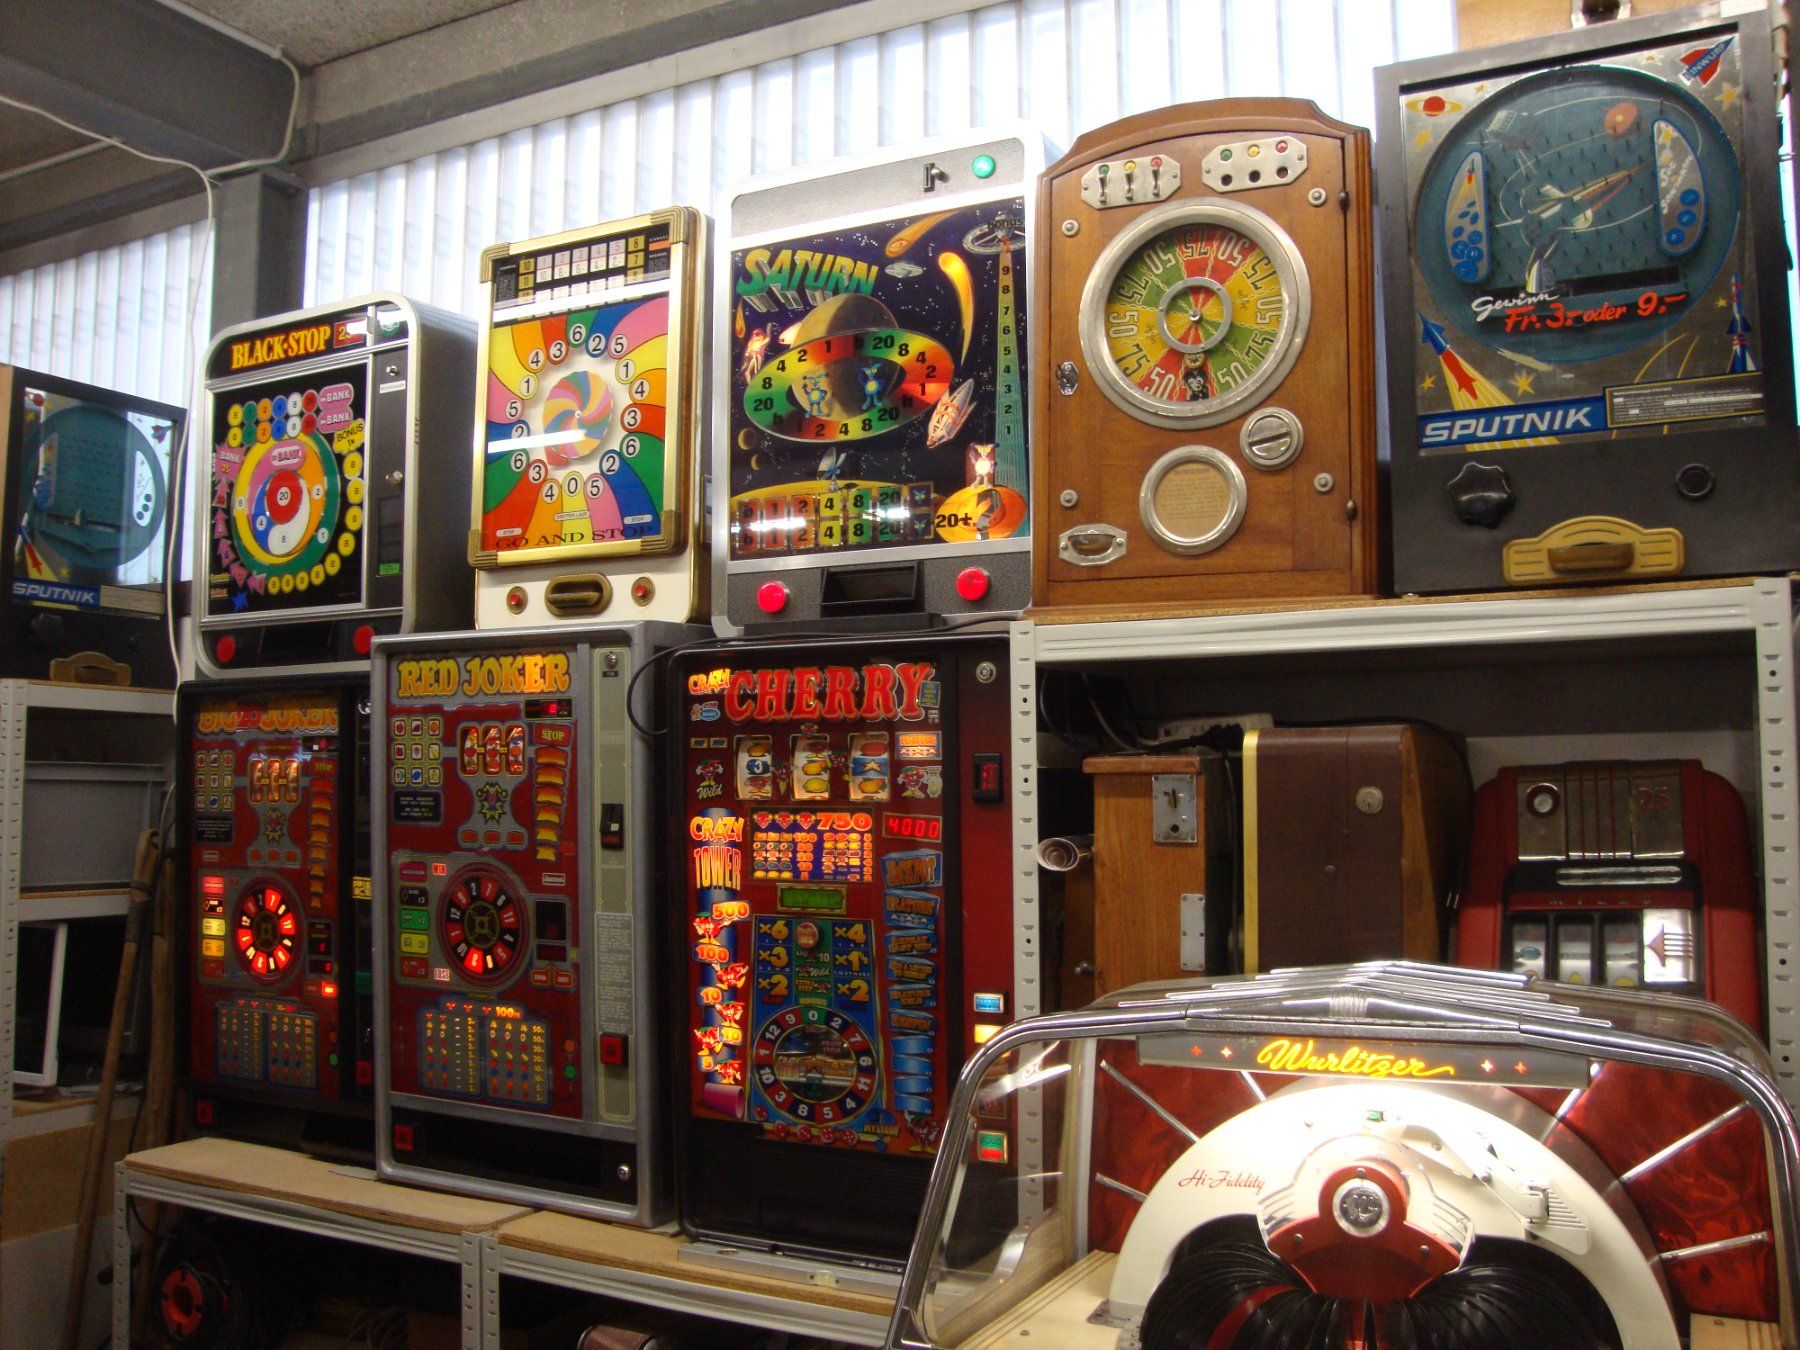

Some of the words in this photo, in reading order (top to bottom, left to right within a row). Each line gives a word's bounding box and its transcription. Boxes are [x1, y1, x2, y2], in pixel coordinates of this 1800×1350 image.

[634, 255, 638, 265] 7
[736, 248, 879, 296] SATURN
[1002, 266, 1010, 275] 9
[1002, 285, 1010, 294] 8
[1003, 306, 1010, 315] 7
[1471, 292, 1560, 322] Gewinn
[1505, 305, 1543, 332] Fr.
[1583, 303, 1627, 323] oder
[572, 325, 583, 342] 6
[1003, 326, 1010, 335] 6
[592, 335, 602, 352] 2
[614, 337, 624, 353] 5
[873, 335, 895, 349] 20
[553, 343, 563, 358] 3
[798, 349, 808, 363] 2
[898, 343, 909, 357] 8
[916, 351, 926, 364] 4
[1004, 347, 1011, 355] 5
[531, 351, 540, 367] 4
[776, 360, 787, 372] 4
[623, 362, 630, 378] 1
[925, 365, 937, 379] 2
[1004, 365, 1011, 374] 4
[524, 379, 531, 394] 1
[634, 381, 645, 398] 4
[762, 376, 772, 390] 8
[1004, 385, 1012, 393] 3
[326, 388, 351, 404] BANK
[510, 400, 518, 417] 5
[754, 400, 773, 411] 20
[1004, 405, 1012, 414] 2
[326, 412, 351, 425] BANK
[627, 409, 637, 427] 3
[877, 407, 899, 421] 20
[515, 425, 524, 438] 2
[816, 424, 825, 436] 2
[839, 422, 849, 436] 4
[861, 418, 872, 431] 8
[1006, 426, 1011, 434] 1
[1423, 406, 1592, 443] SPUTNIK
[336, 424, 363, 443] BONUS
[626, 438, 637, 455] 6
[513, 453, 524, 469] 6
[605, 455, 616, 472] 2
[532, 465, 542, 481] 3
[545, 484, 555, 501] 4
[568, 478, 578, 494] 0
[590, 479, 600, 496] 5
[279, 490, 289, 501] 20
[824, 497, 834, 511] 4
[853, 493, 864, 509] 8
[496, 537, 528, 549] GO
[536, 532, 585, 546] AND
[592, 526, 653, 540] STOP
[824, 525, 834, 539] 4
[853, 523, 864, 538] 8
[12, 582, 96, 604] SPUTNIK
[398, 659, 459, 697] RED
[463, 653, 569, 696] JOKER
[689, 669, 730, 694] CRAZY
[724, 664, 932, 721] CHERRY
[542, 729, 564, 741] STOP
[754, 761, 762, 773] 3
[697, 784, 723, 799] Wild
[690, 816, 744, 843] CRAZY
[816, 813, 872, 831] 750
[888, 819, 940, 838] 4000
[694, 846, 742, 890] TOWER
[712, 901, 750, 920] 500
[696, 944, 729, 963] 100
[811, 967, 829, 976] Wild
[700, 987, 722, 1003] 10
[785, 1013, 796, 1024] 9
[808, 1010, 818, 1020] 0
[830, 1018, 842, 1028] 2
[765, 1025, 780, 1040] 12
[850, 1033, 862, 1042] 7
[760, 1048, 769, 1056] 1
[1257, 1039, 1455, 1078] Wurlitzer
[857, 1077, 871, 1091] 11
[774, 1092, 786, 1102] 3
[846, 1097, 856, 1109] 4
[798, 1104, 808, 1116] 8
[823, 1107, 833, 1118] 5
[1178, 1169, 1266, 1196] Hi-Fidelity
